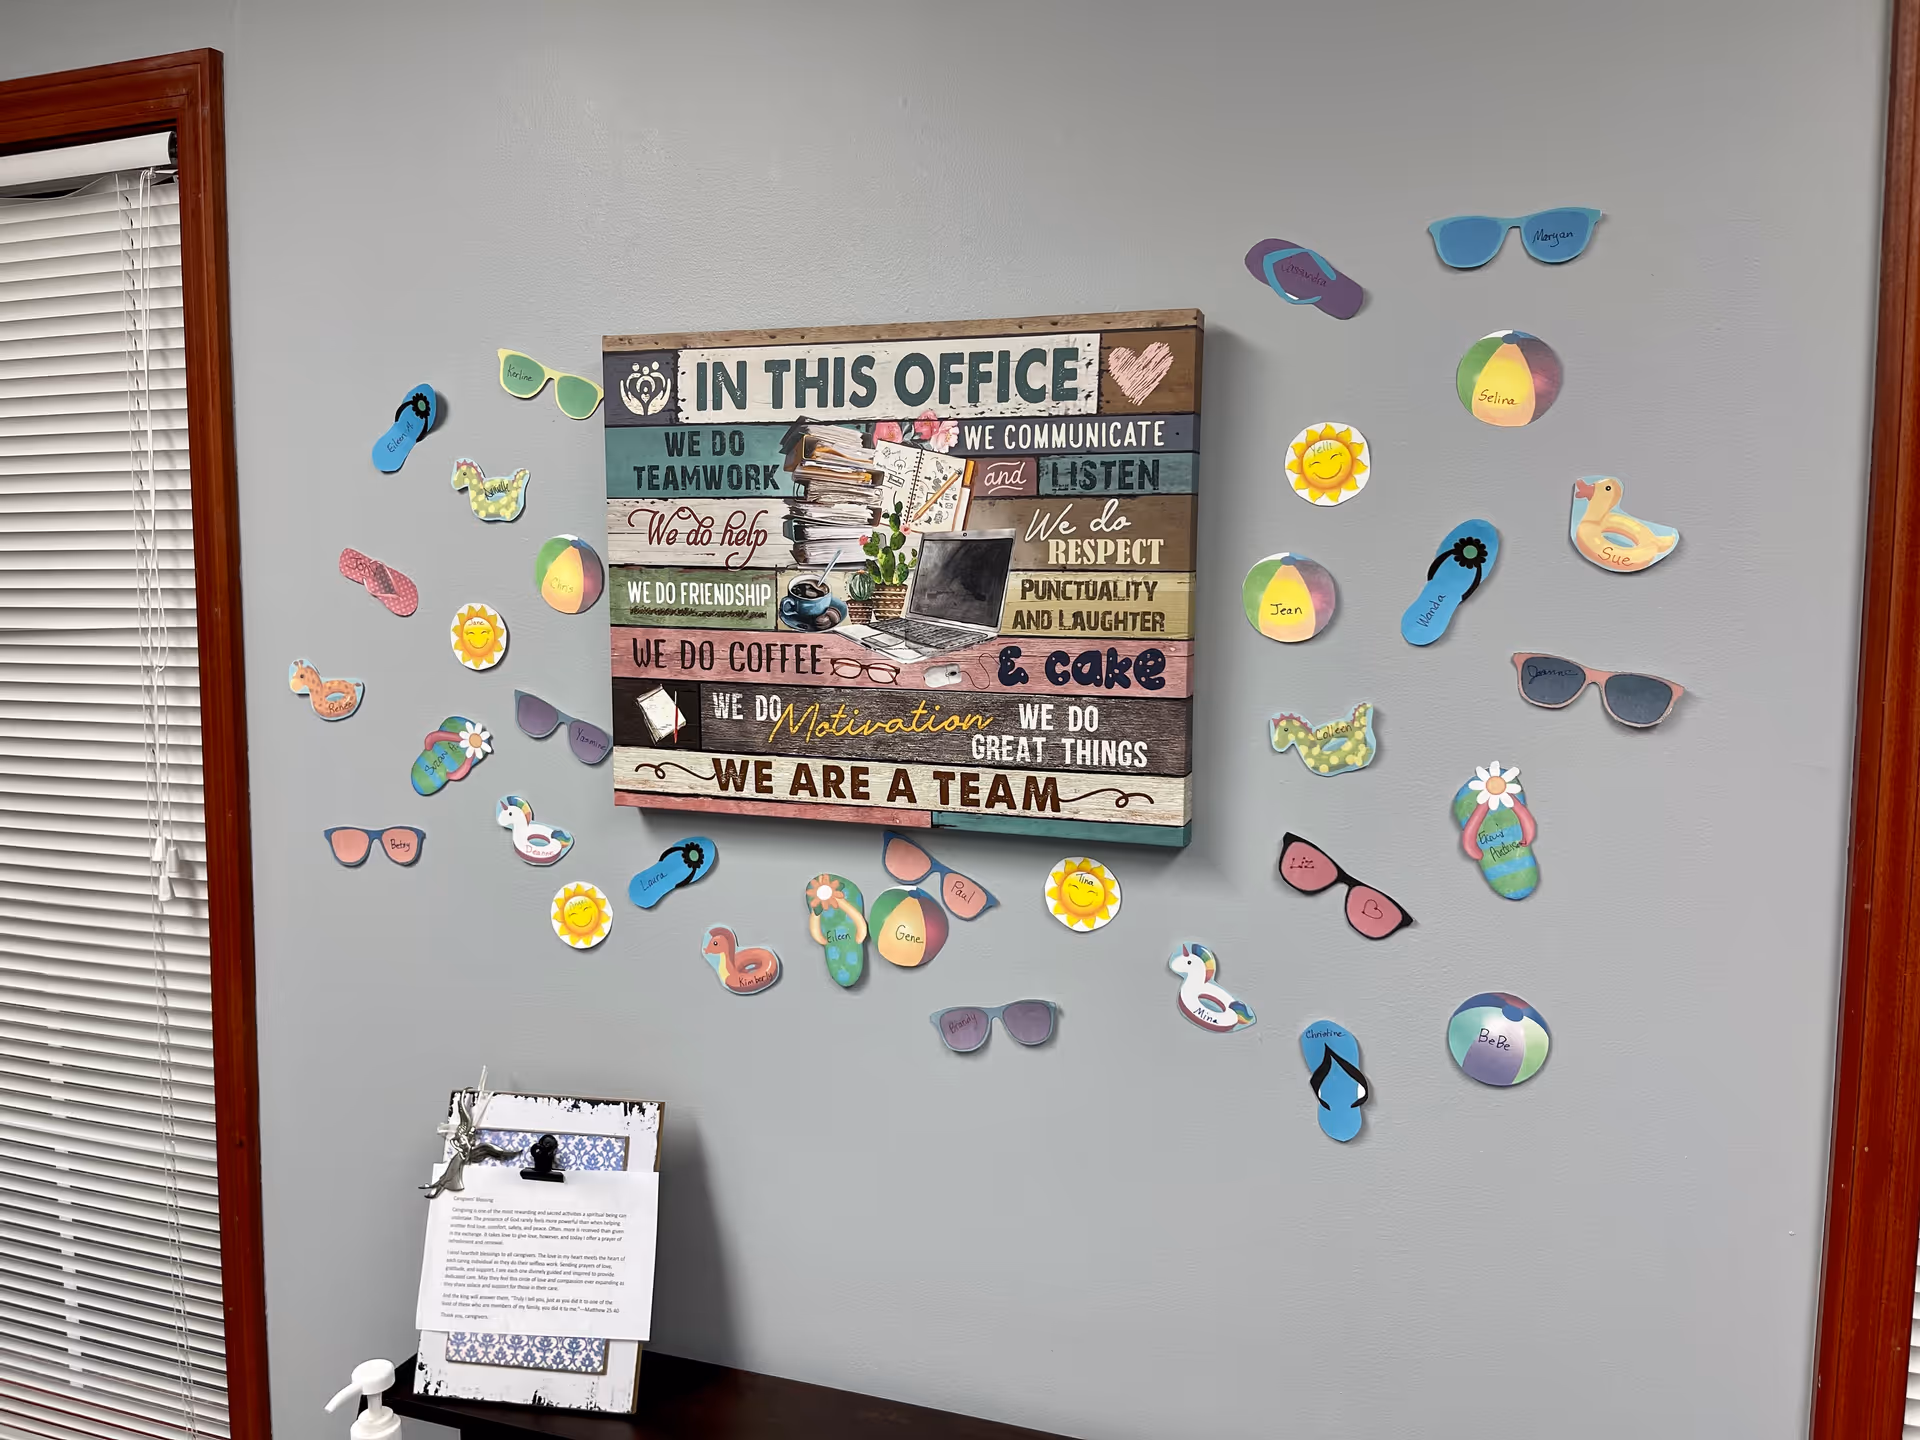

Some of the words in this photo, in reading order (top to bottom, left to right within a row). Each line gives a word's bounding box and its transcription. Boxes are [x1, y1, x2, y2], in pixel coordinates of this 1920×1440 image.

[696, 360, 747, 411] IN
[764, 355, 877, 409] THIS
[894, 347, 1079, 407] OFFICE
[1478, 389, 1518, 407] Selina
[664, 431, 700, 457] WE
[711, 430, 745, 457] DO
[964, 424, 995, 450] WE
[1004, 420, 1165, 449] COMMUNICATE
[633, 463, 780, 491] TEAMWORK
[984, 462, 1027, 487] and
[1051, 459, 1160, 491] LISTEN
[1025, 503, 1077, 542] We
[1089, 498, 1132, 532] do
[627, 506, 685, 546] We
[681, 506, 714, 546] do
[720, 510, 768, 571] help
[1048, 538, 1165, 565] RESPECT
[1598, 547, 1635, 567] Sue
[627, 581, 651, 604] WE
[655, 581, 676, 605] DO
[680, 582, 771, 607] FRIENDSHIP
[1020, 579, 1158, 602] PUNCTUALITY
[1012, 609, 1051, 631] AND
[1058, 610, 1165, 632] LAUGHTER
[1270, 603, 1303, 616] Jean
[1416, 593, 1446, 628] Wanda
[632, 637, 667, 669] WE
[680, 639, 715, 670] DO
[729, 641, 825, 675] COFFEE
[998, 645, 1029, 687] &
[1044, 647, 1166, 690] cake
[712, 692, 744, 720] WE
[755, 694, 783, 721] DO
[1018, 703, 1054, 731] WE
[1068, 705, 1099, 733] DO
[768, 699, 994, 743] Motivation
[1314, 723, 1353, 741] Colleen
[971, 734, 1046, 763] GREAT
[1061, 738, 1148, 768] THINGS
[711, 757, 774, 794] WE
[789, 763, 870, 800] ARE
[886, 768, 917, 804] A
[933, 770, 1061, 812] TEAM
[390, 838, 411, 852] Betsy
[1289, 856, 1314, 869] Liz
[640, 872, 667, 892] Laura
[950, 880, 974, 904] Paul
[1075, 872, 1094, 887] Tina
[895, 924, 924, 944] Gene
[1193, 1007, 1219, 1025] Mina
[1478, 1028, 1512, 1051] BeBe
